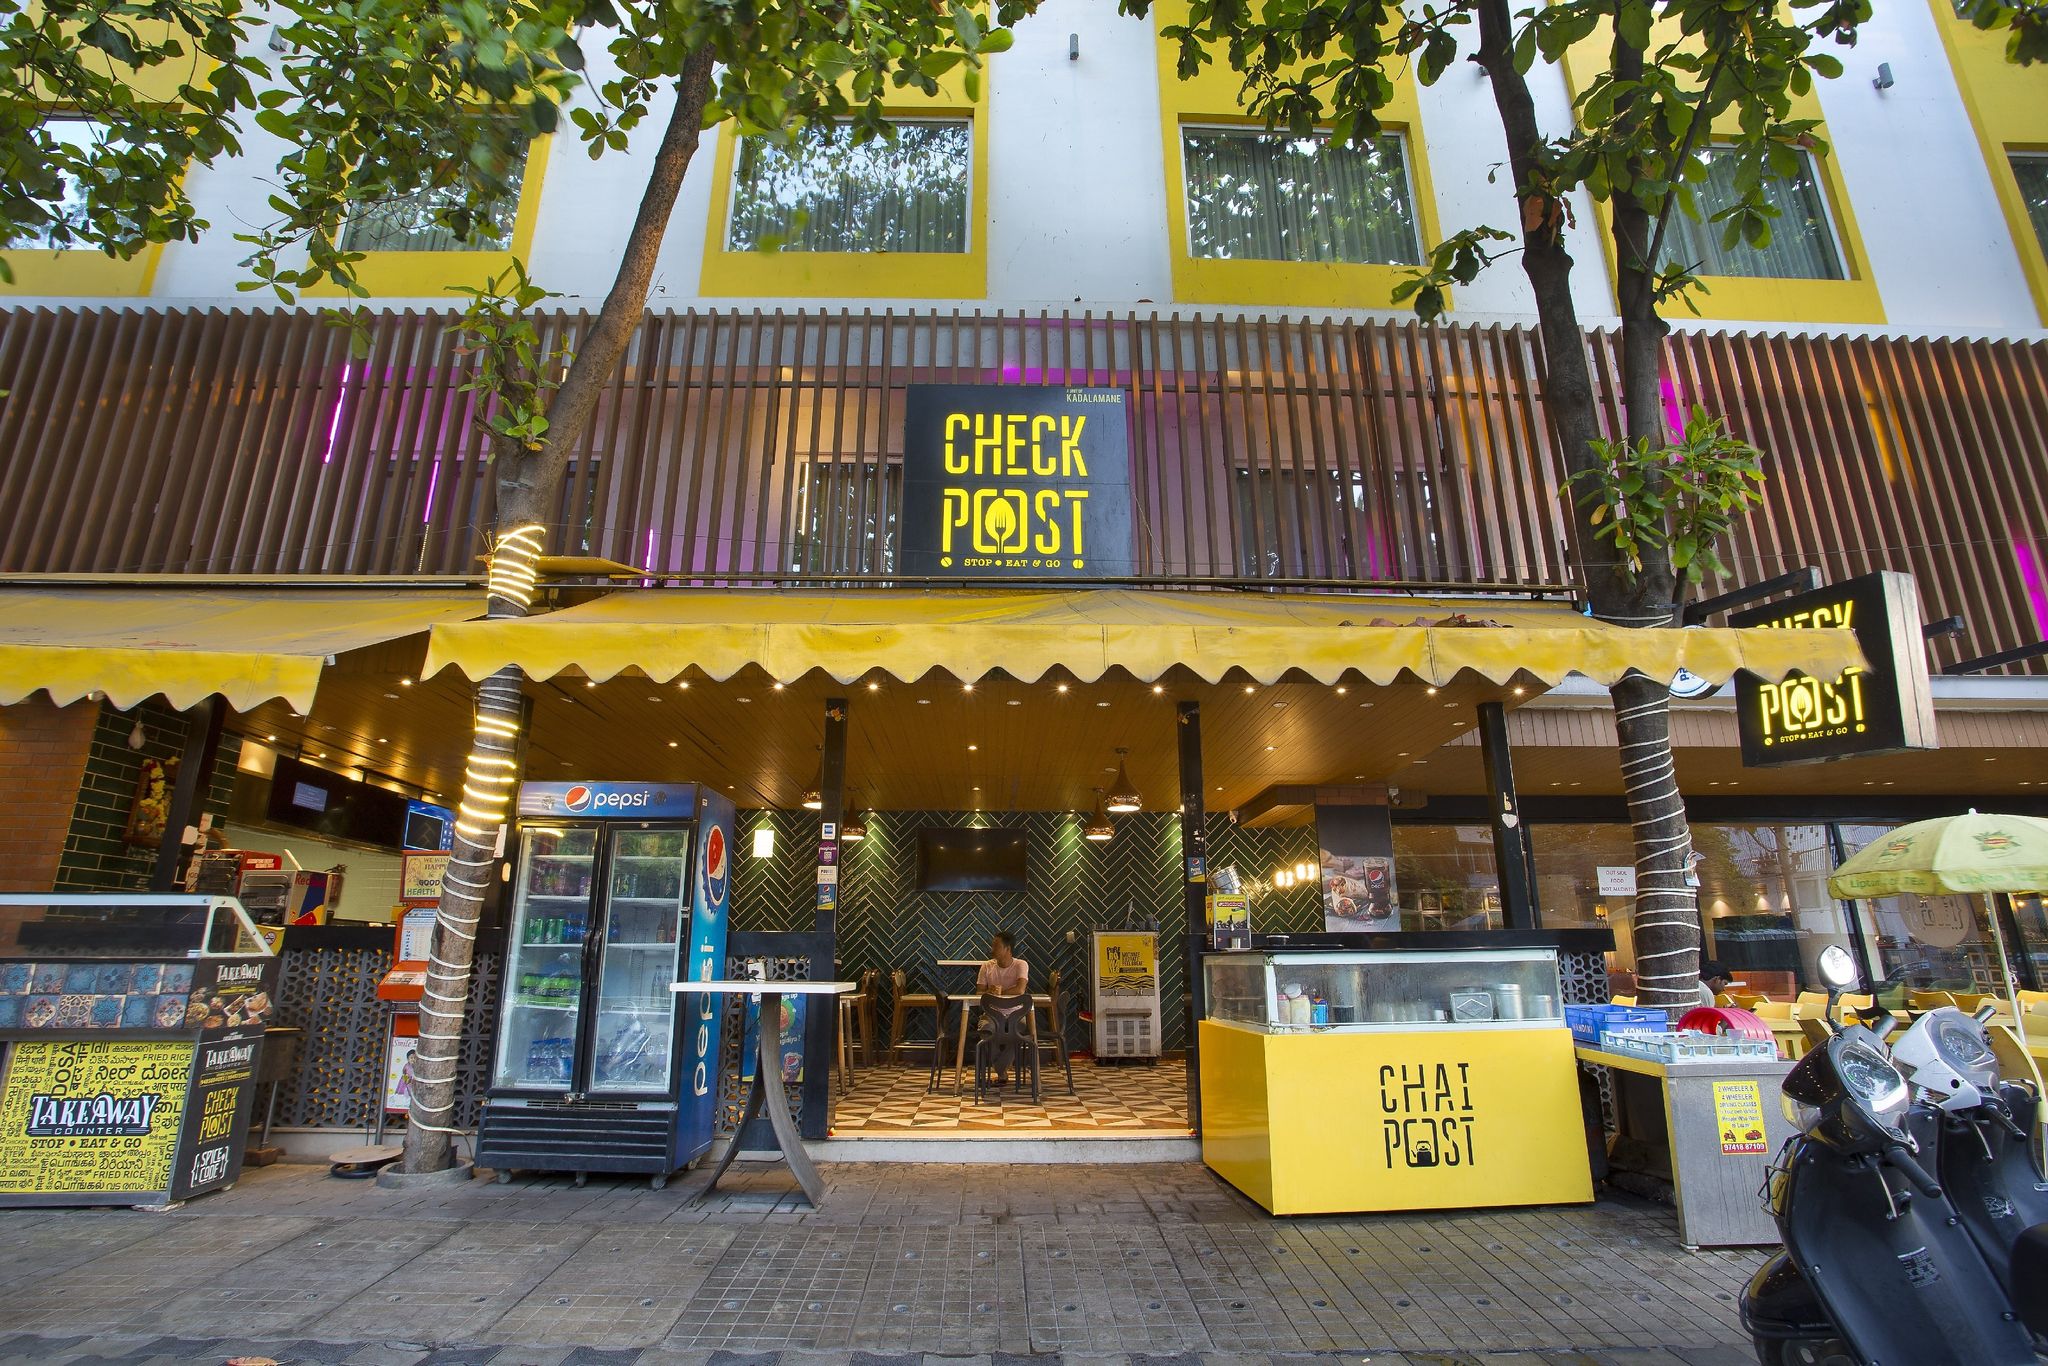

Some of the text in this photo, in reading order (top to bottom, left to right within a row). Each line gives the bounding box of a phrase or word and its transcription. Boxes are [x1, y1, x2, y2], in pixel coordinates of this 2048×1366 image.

[1066, 394, 1121, 403] KADALAMANE
[945, 413, 1088, 477] CHECK
[942, 488, 1089, 555] POST
[964, 558, 1060, 568] STOP EAT & GO
[1780, 733, 1800, 743] STOP
[1808, 730, 1824, 739] EAT
[1836, 726, 1848, 735] GO
[593, 790, 649, 810] pepsi
[407, 888, 435, 896] HEALTH
[217, 964, 265, 982] TAKEAWAY
[91, 1042, 110, 1053] Idli
[393, 1038, 412, 1047] Smile
[142, 1053, 191, 1061] FRIED RICE
[205, 1044, 255, 1068] TAKEAWAY
[51, 1042, 78, 1096] DOSA
[1380, 1062, 1474, 1113] CHAI
[205, 1086, 240, 1115] CHECK
[30, 1094, 159, 1128] TAKEAWAY
[199, 1110, 236, 1141] POST
[30, 1138, 64, 1148] STOP
[79, 1138, 107, 1148] EAT
[110, 1138, 120, 1148] &
[124, 1137, 141, 1148] GO
[1384, 1117, 1475, 1169] POST
[200, 1147, 223, 1168] SPICE
[93, 1170, 120, 1178] FRIED
[123, 1170, 146, 1178] RICE
[158, 1165, 171, 1189] EGG
